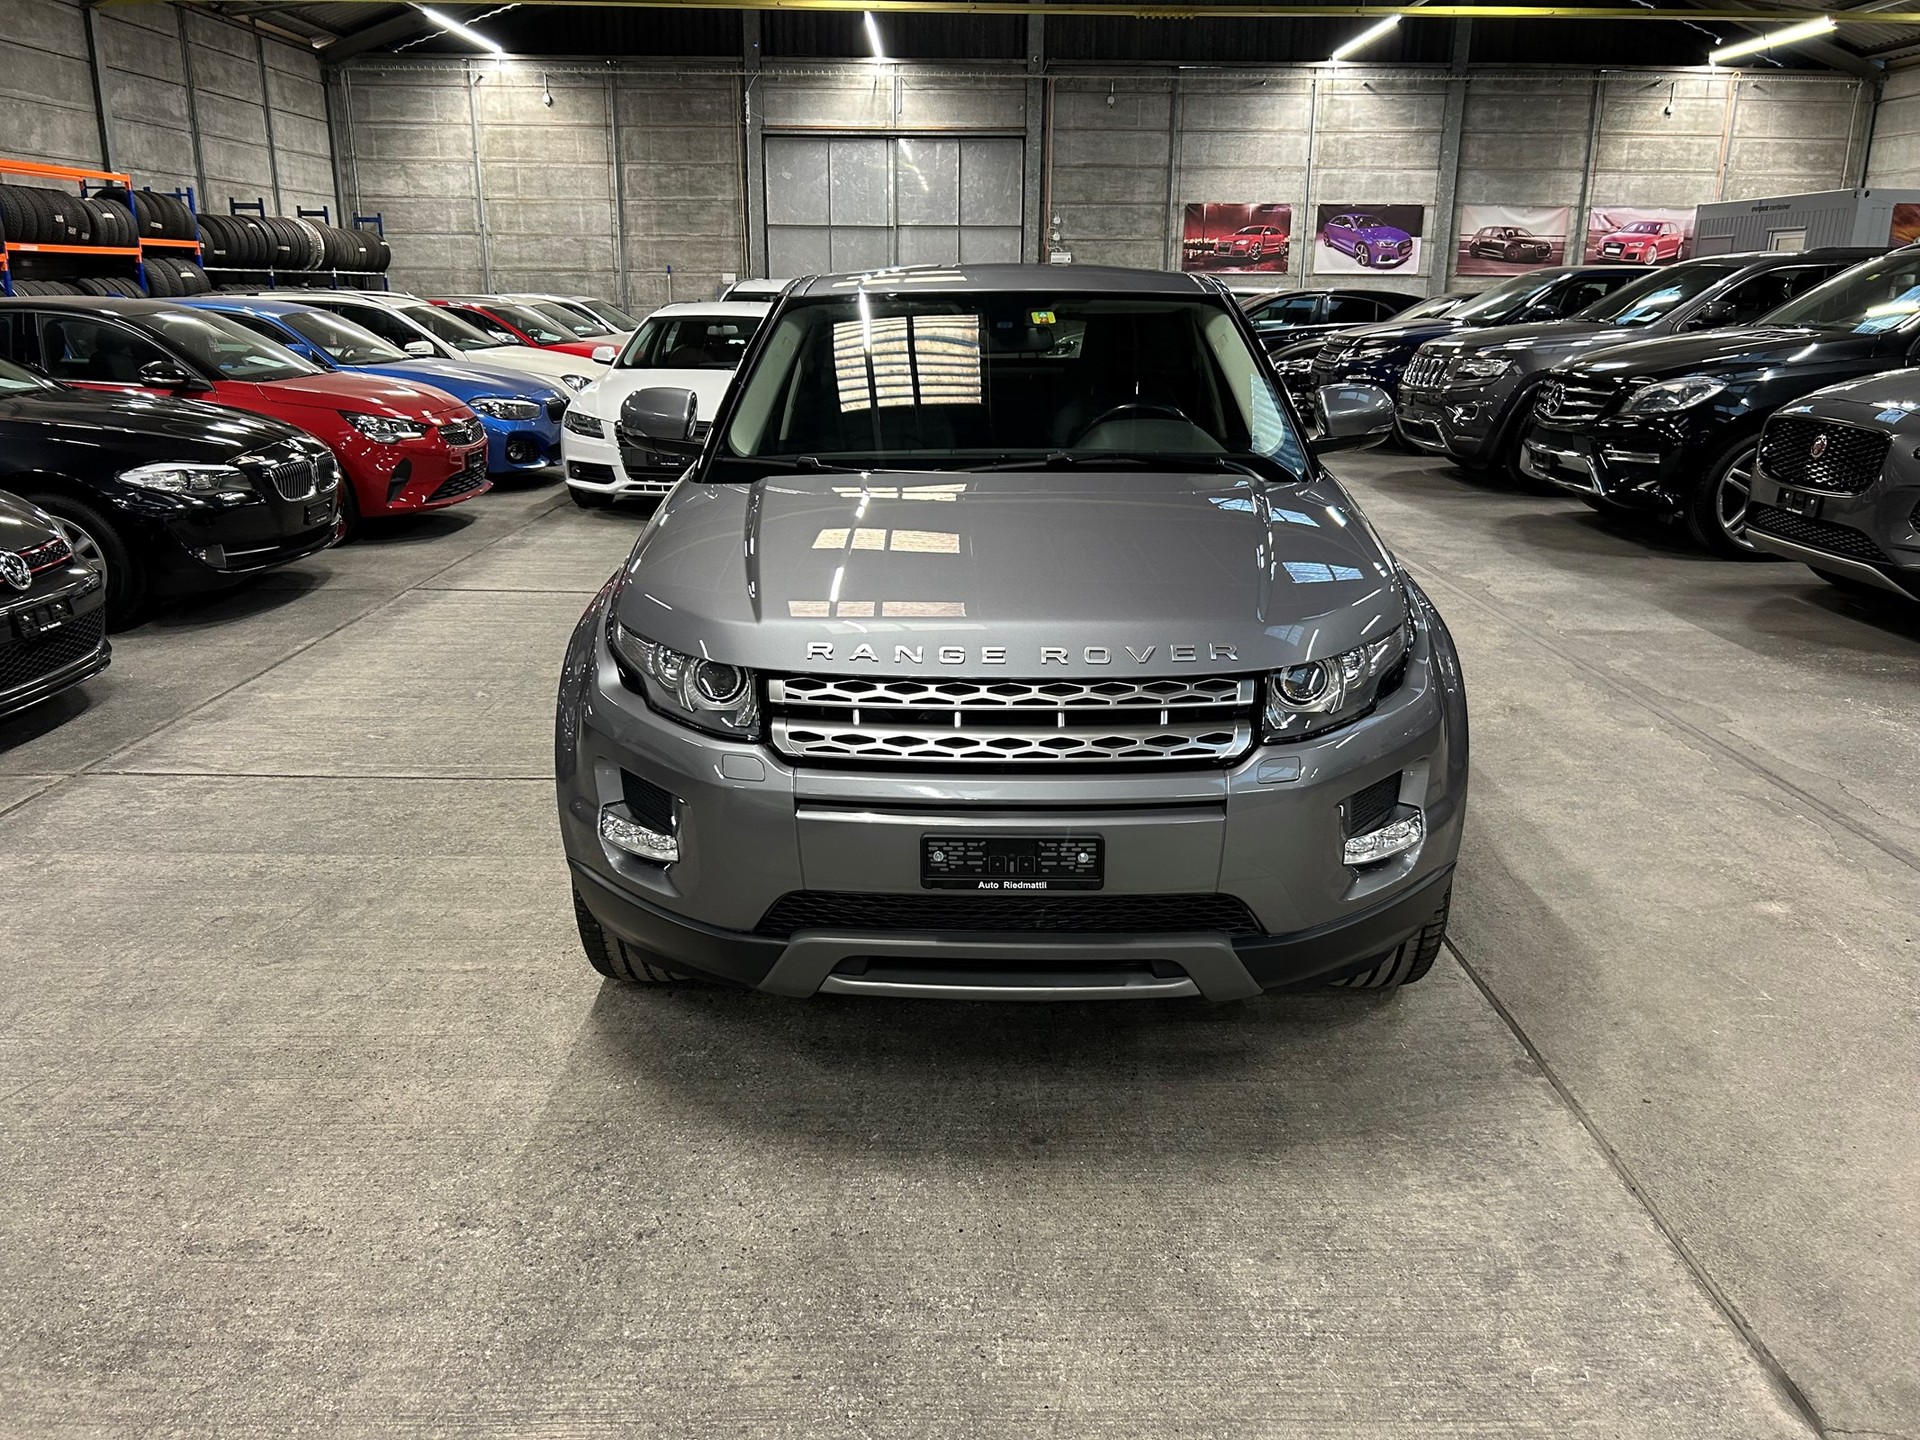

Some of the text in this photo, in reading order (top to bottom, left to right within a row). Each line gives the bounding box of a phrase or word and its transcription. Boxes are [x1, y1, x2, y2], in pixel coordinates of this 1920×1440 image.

[806, 642, 1239, 665] RANGE ROVER
[978, 881, 999, 889] Auto
